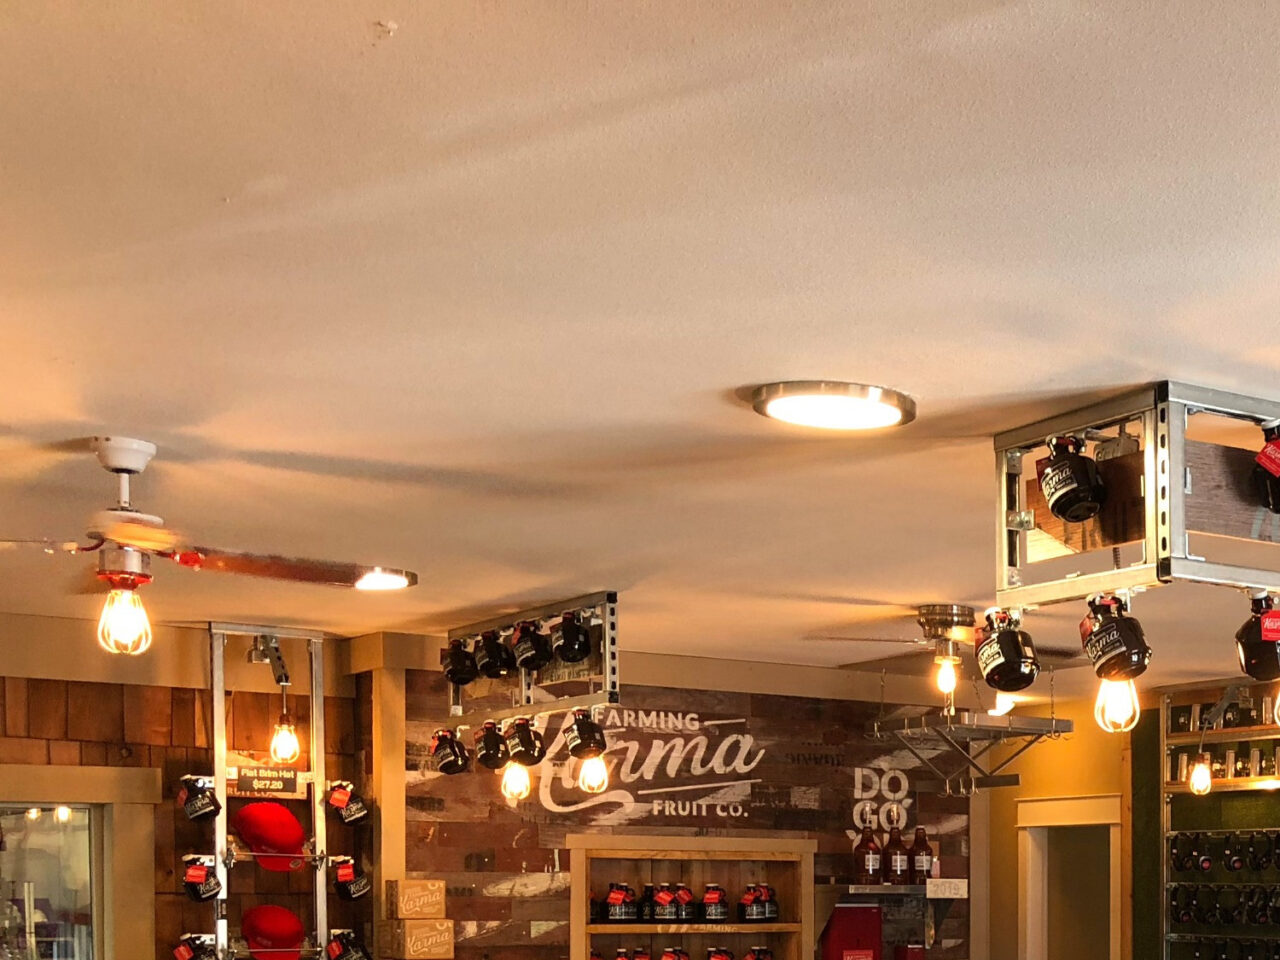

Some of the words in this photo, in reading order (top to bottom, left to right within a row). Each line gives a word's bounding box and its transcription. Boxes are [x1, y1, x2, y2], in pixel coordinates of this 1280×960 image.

[594, 707, 699, 731] FARMING
[241, 768, 258, 779] Flat
[279, 769, 295, 780] Hat
[252, 780, 284, 790] $27.20
[854, 767, 909, 800] DO
[652, 800, 708, 817] FRUIT
[715, 803, 749, 818] CO.
[853, 799, 908, 831] GO
[400, 891, 440, 914] Karma
[407, 931, 450, 955] Karma
